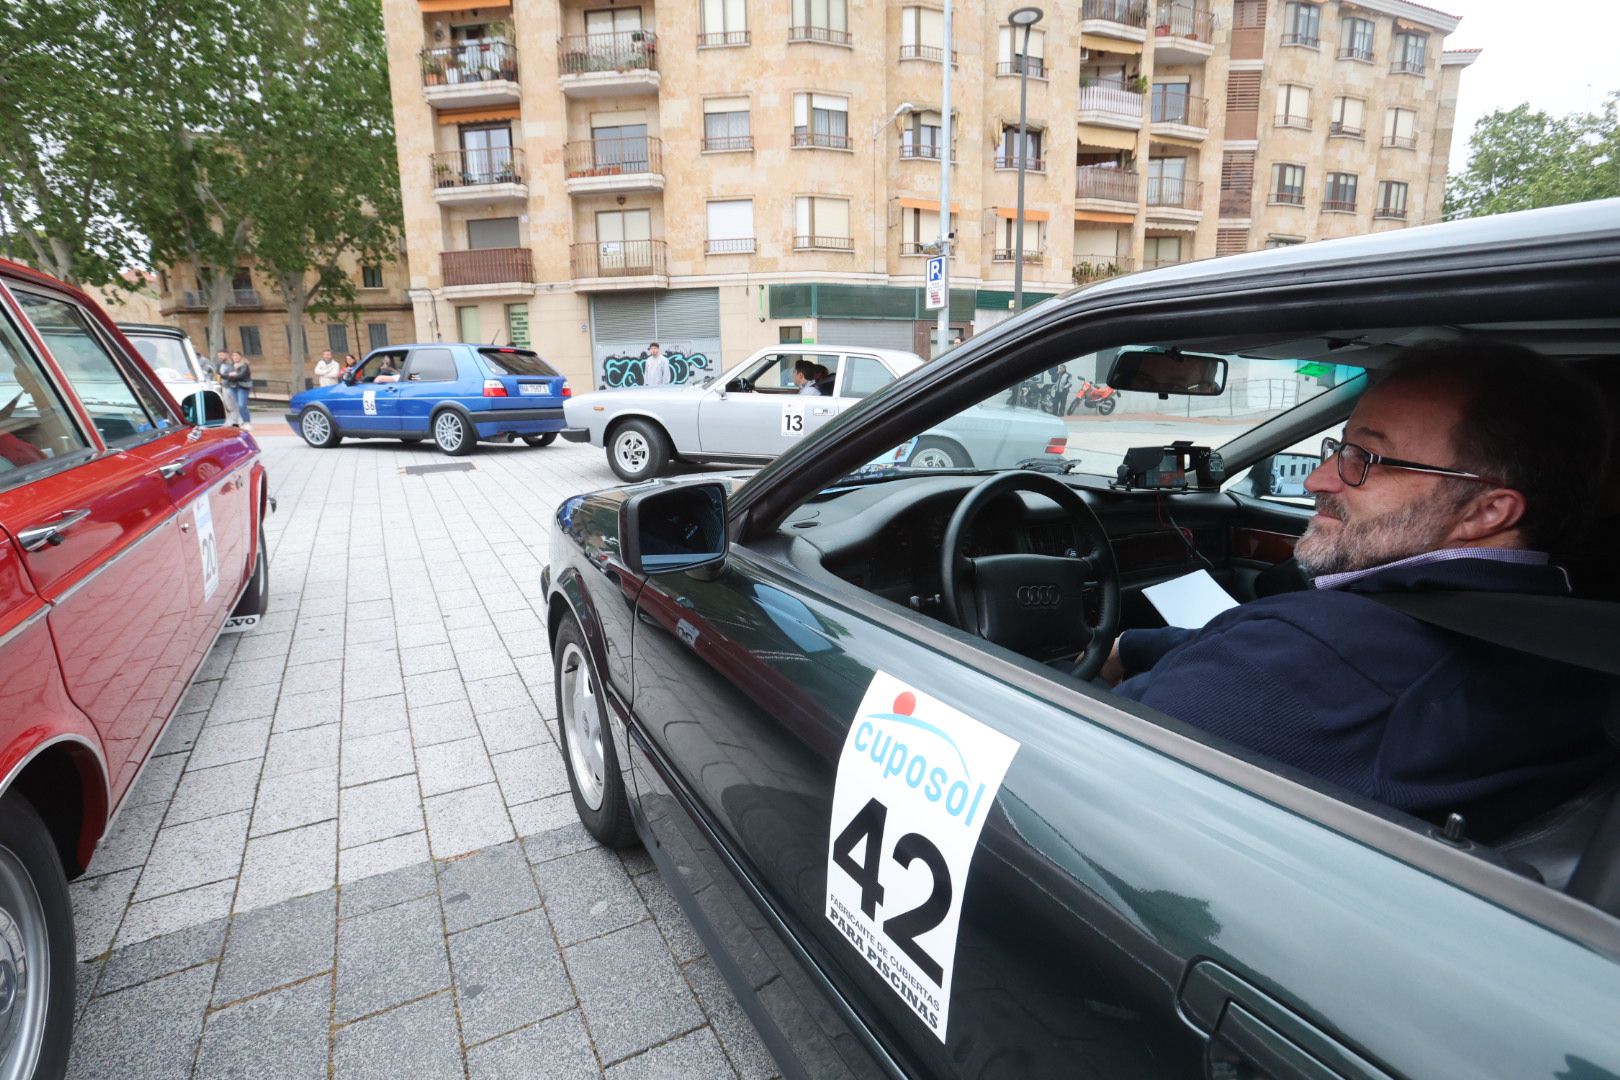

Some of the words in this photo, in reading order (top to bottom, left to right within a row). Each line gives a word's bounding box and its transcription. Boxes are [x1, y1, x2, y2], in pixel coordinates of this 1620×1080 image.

[785, 414, 803, 432] 13
[202, 532, 217, 582] 20
[224, 617, 256, 628] LVO
[854, 721, 986, 828] cuposol
[832, 797, 953, 989] 42
[829, 906, 865, 952] PARA
[866, 946, 939, 1030] PISCINAS
[830, 893, 875, 946] FABRICANTE
[876, 936, 888, 958] DE
[890, 955, 940, 1012] CUBIERTAS
